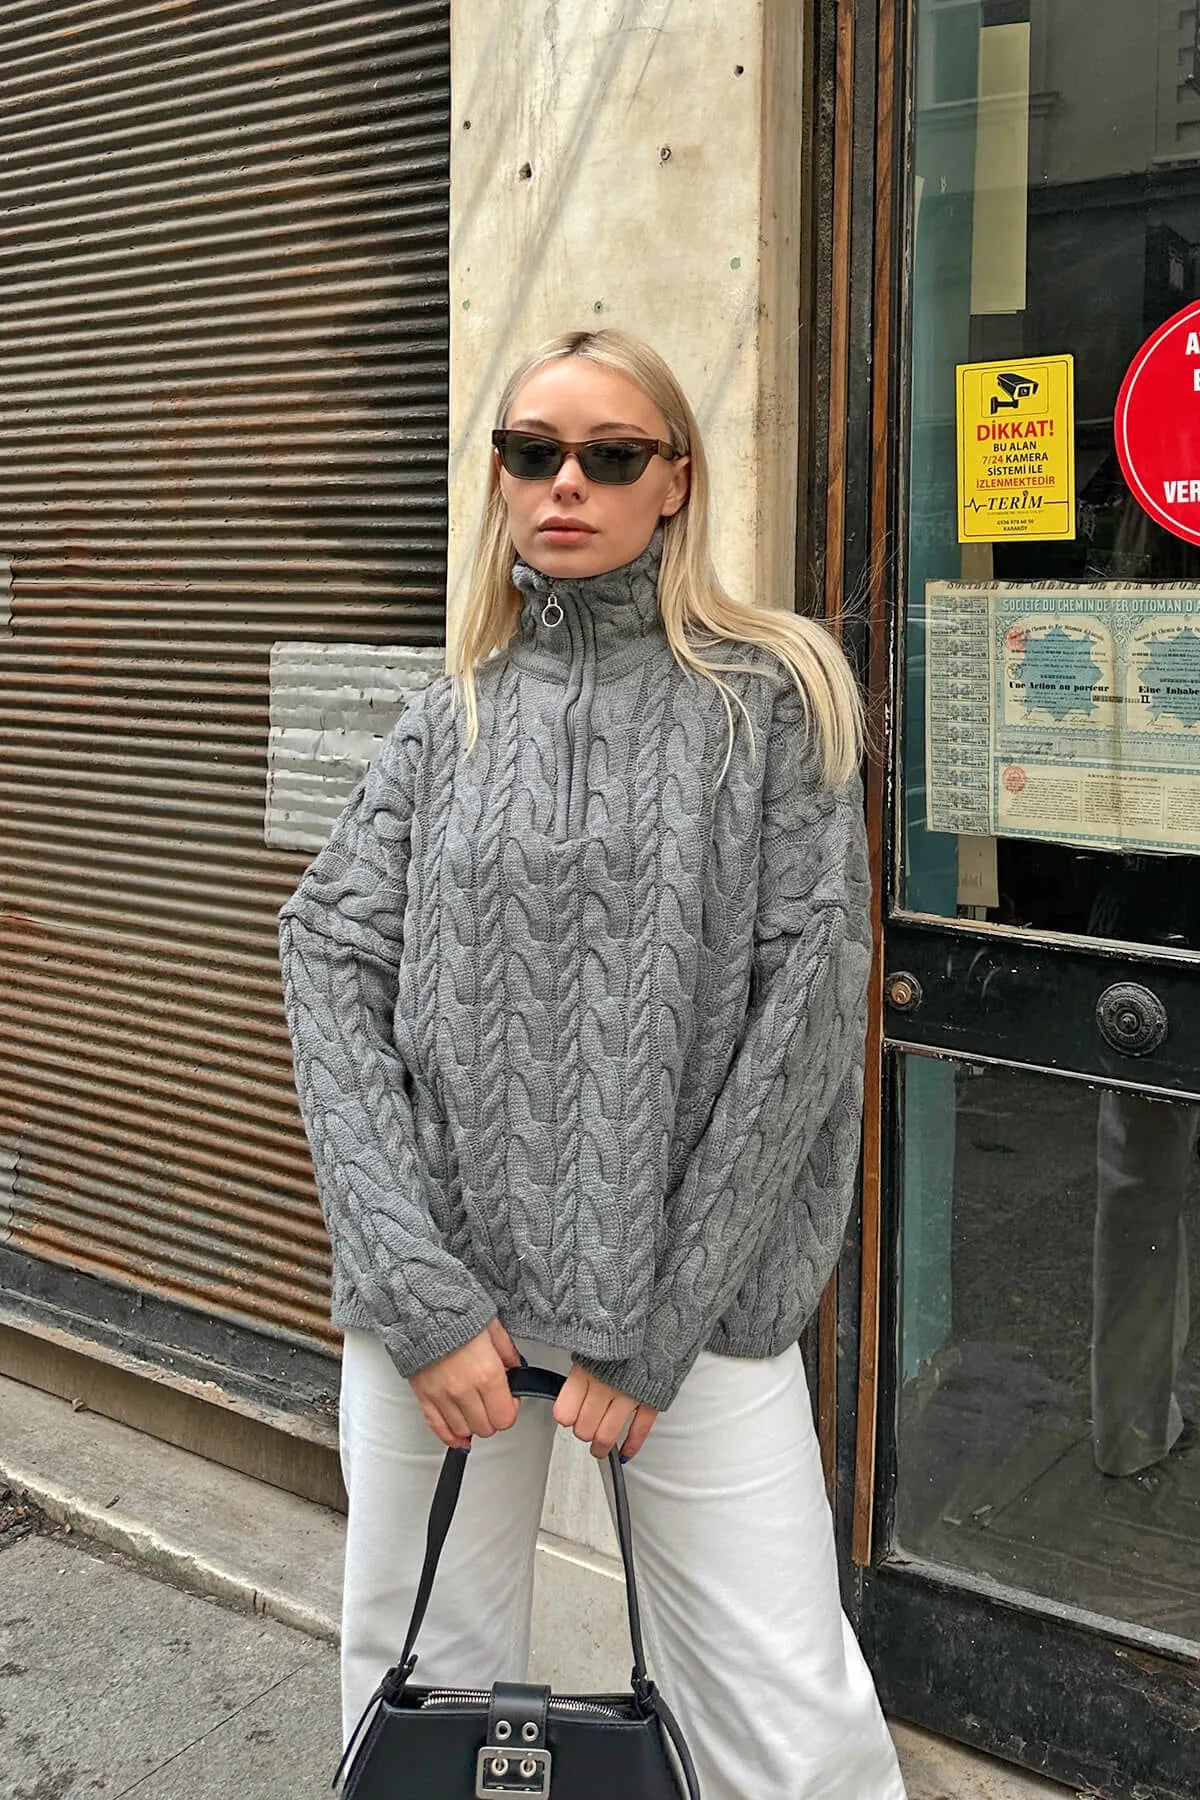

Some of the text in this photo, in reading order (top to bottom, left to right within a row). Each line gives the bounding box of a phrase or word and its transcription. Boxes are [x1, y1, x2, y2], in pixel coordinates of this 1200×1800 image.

[1184, 331, 1200, 355] A
[977, 420, 1054, 441] DİKKAT!
[993, 441, 1037, 452] BU ALAN
[982, 452, 1049, 465] 7/24 KAMERA
[987, 464, 1043, 476] SİSTEMİ İLE
[976, 475, 1056, 489] İZLENMEKTEDİR
[1163, 480, 1200, 503] VER
[988, 490, 1043, 510] TERİM
[1042, 599, 1055, 611] DU
[1057, 599, 1095, 611] CHEMIN
[1097, 599, 1108, 611] DE
[1111, 600, 1129, 611] FER
[1132, 600, 1182, 612] OTTOMAN
[1009, 681, 1026, 689] Une
[1029, 682, 1056, 690] Action
[1074, 684, 1110, 692] porteur
[1138, 685, 1161, 694] Eine
